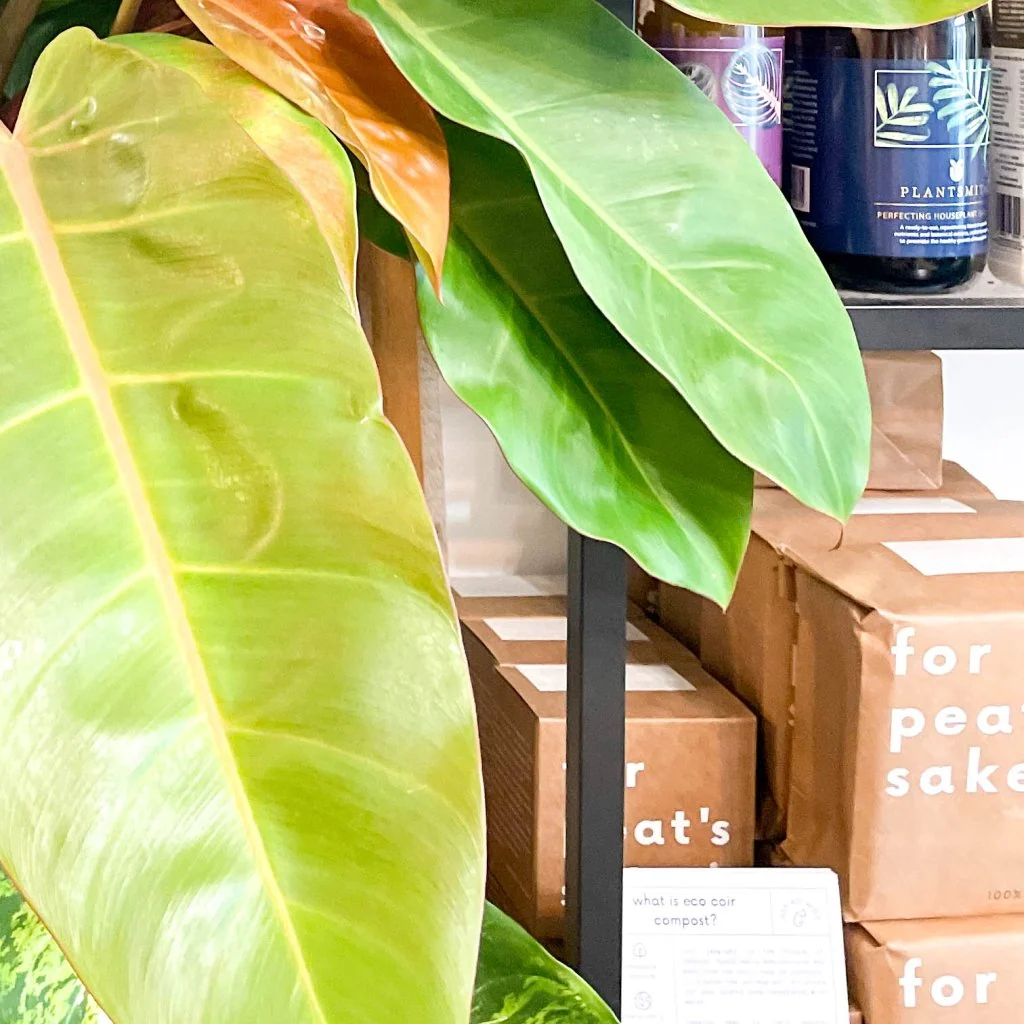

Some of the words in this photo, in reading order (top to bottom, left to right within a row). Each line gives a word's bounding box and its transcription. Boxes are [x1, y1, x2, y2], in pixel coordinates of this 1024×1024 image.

[877, 211, 932, 221] PERFECTING
[890, 626, 992, 676] for
[889, 703, 1024, 754] pea
[884, 746, 1024, 797] sake
[624, 807, 730, 846] at's
[632, 892, 665, 907] what
[669, 897, 679, 907] is
[683, 898, 707, 907] eco
[710, 897, 736, 907] coir
[654, 913, 717, 928] compost?
[898, 957, 998, 1008] for
